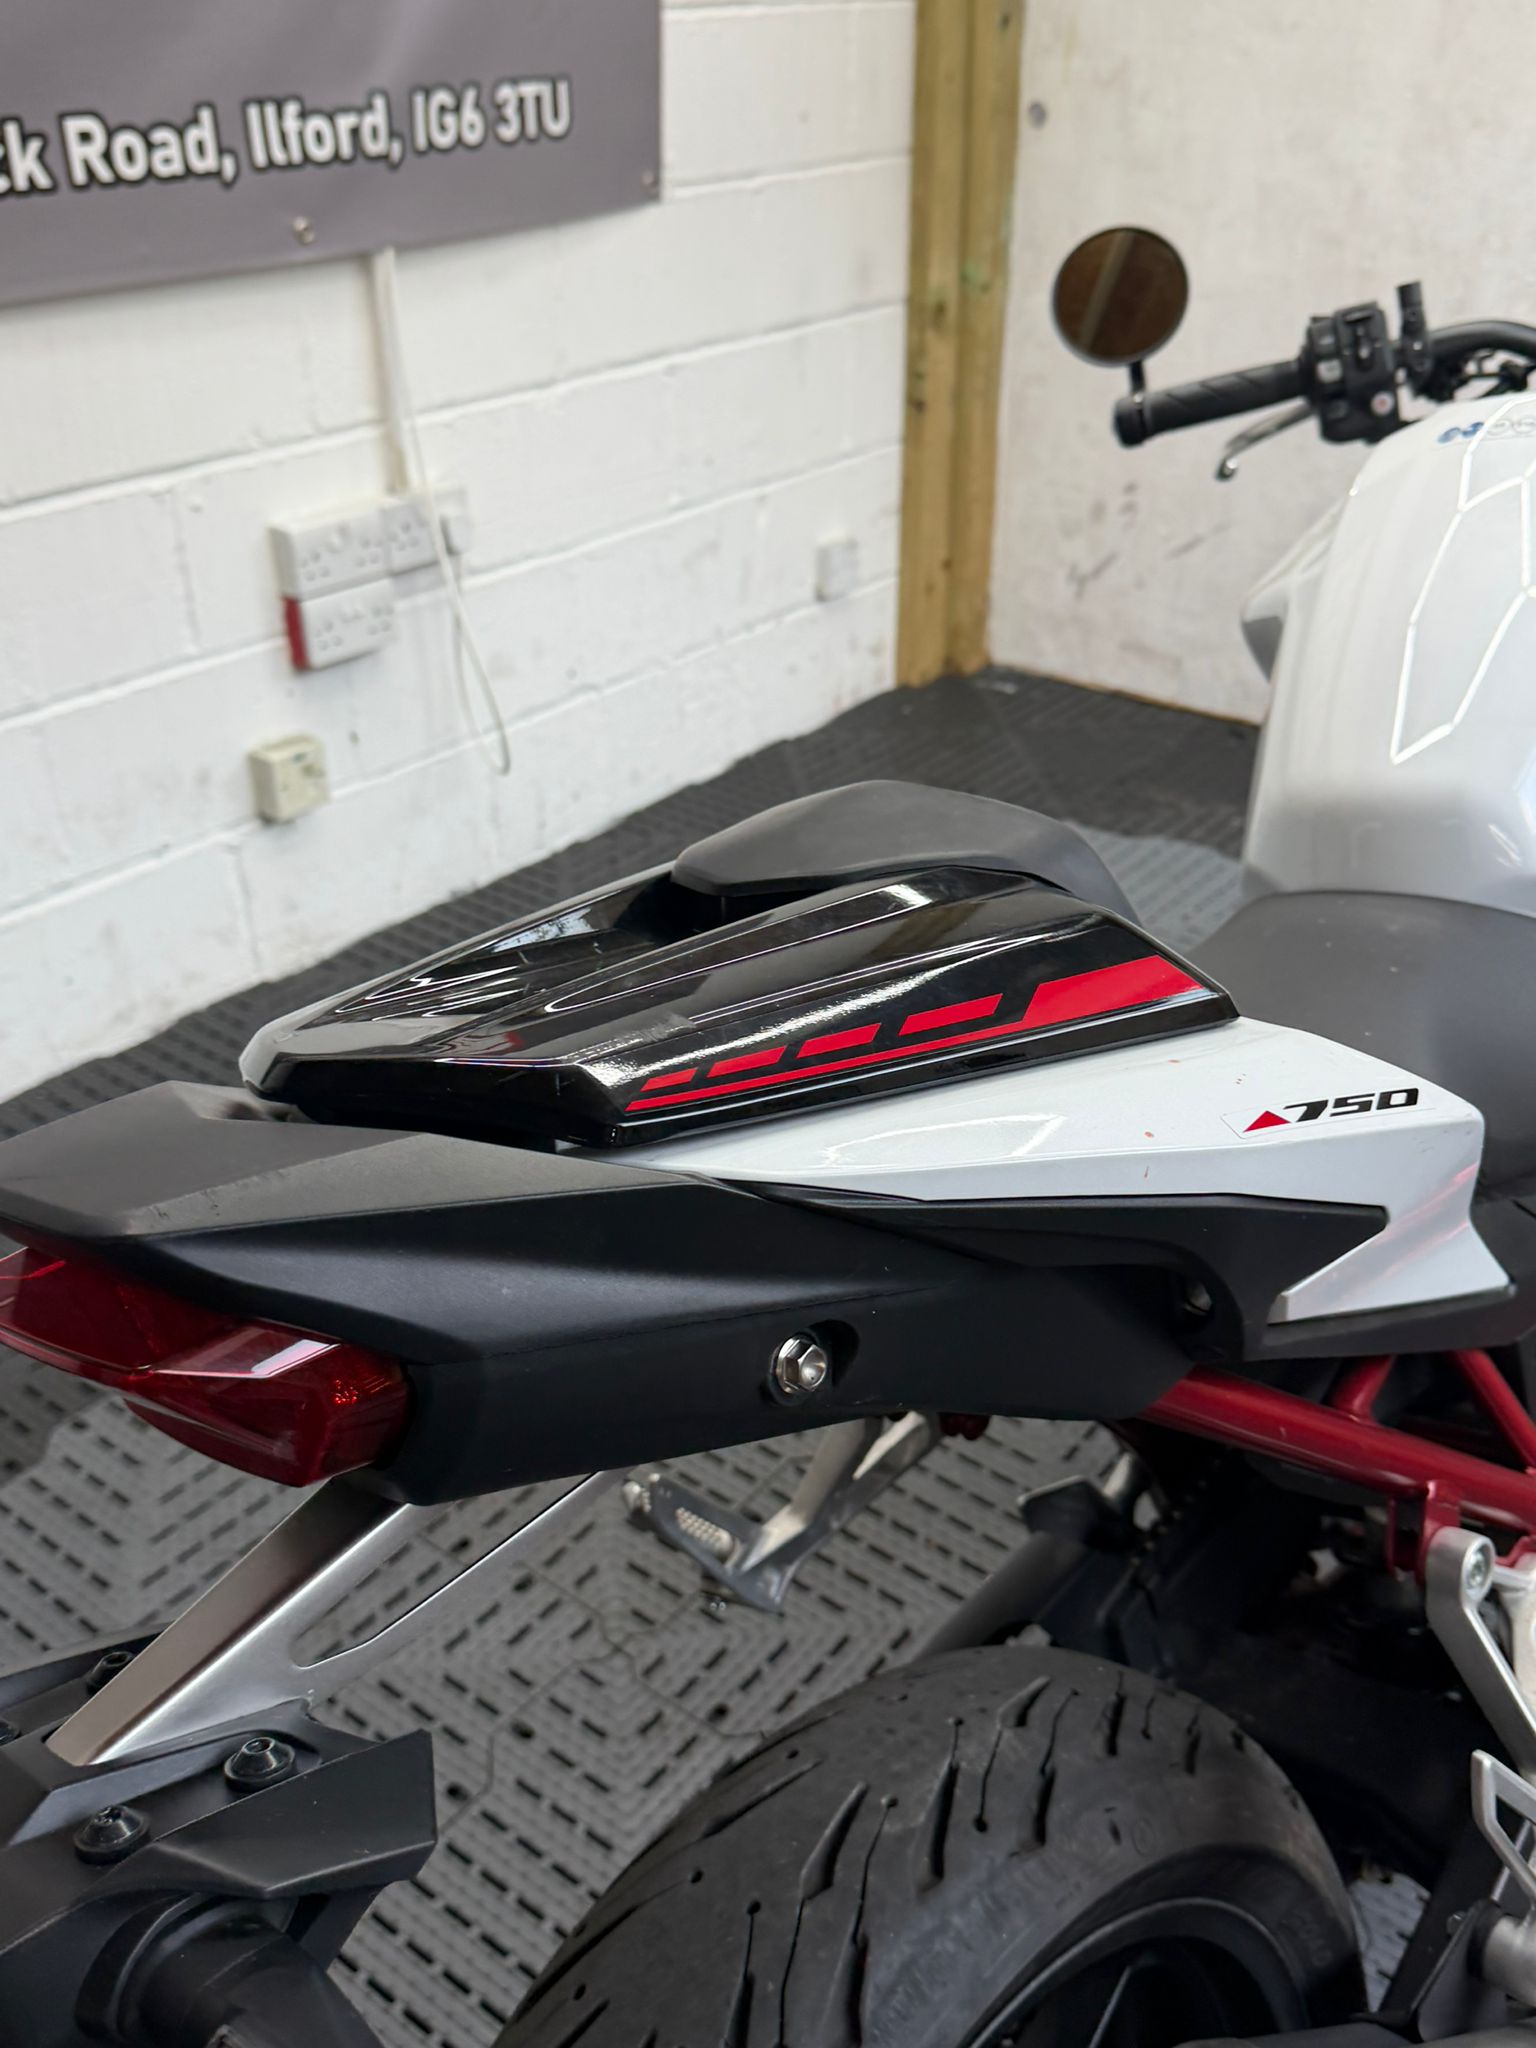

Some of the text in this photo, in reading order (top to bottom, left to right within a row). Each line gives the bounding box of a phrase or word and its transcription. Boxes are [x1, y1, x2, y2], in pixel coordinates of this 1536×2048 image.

[60, 103, 238, 187] Road,
[245, 92, 401, 169] Ilford,
[412, 86, 486, 152] IG6
[495, 80, 571, 144] 3TU
[1283, 1087, 1419, 1123] 750
